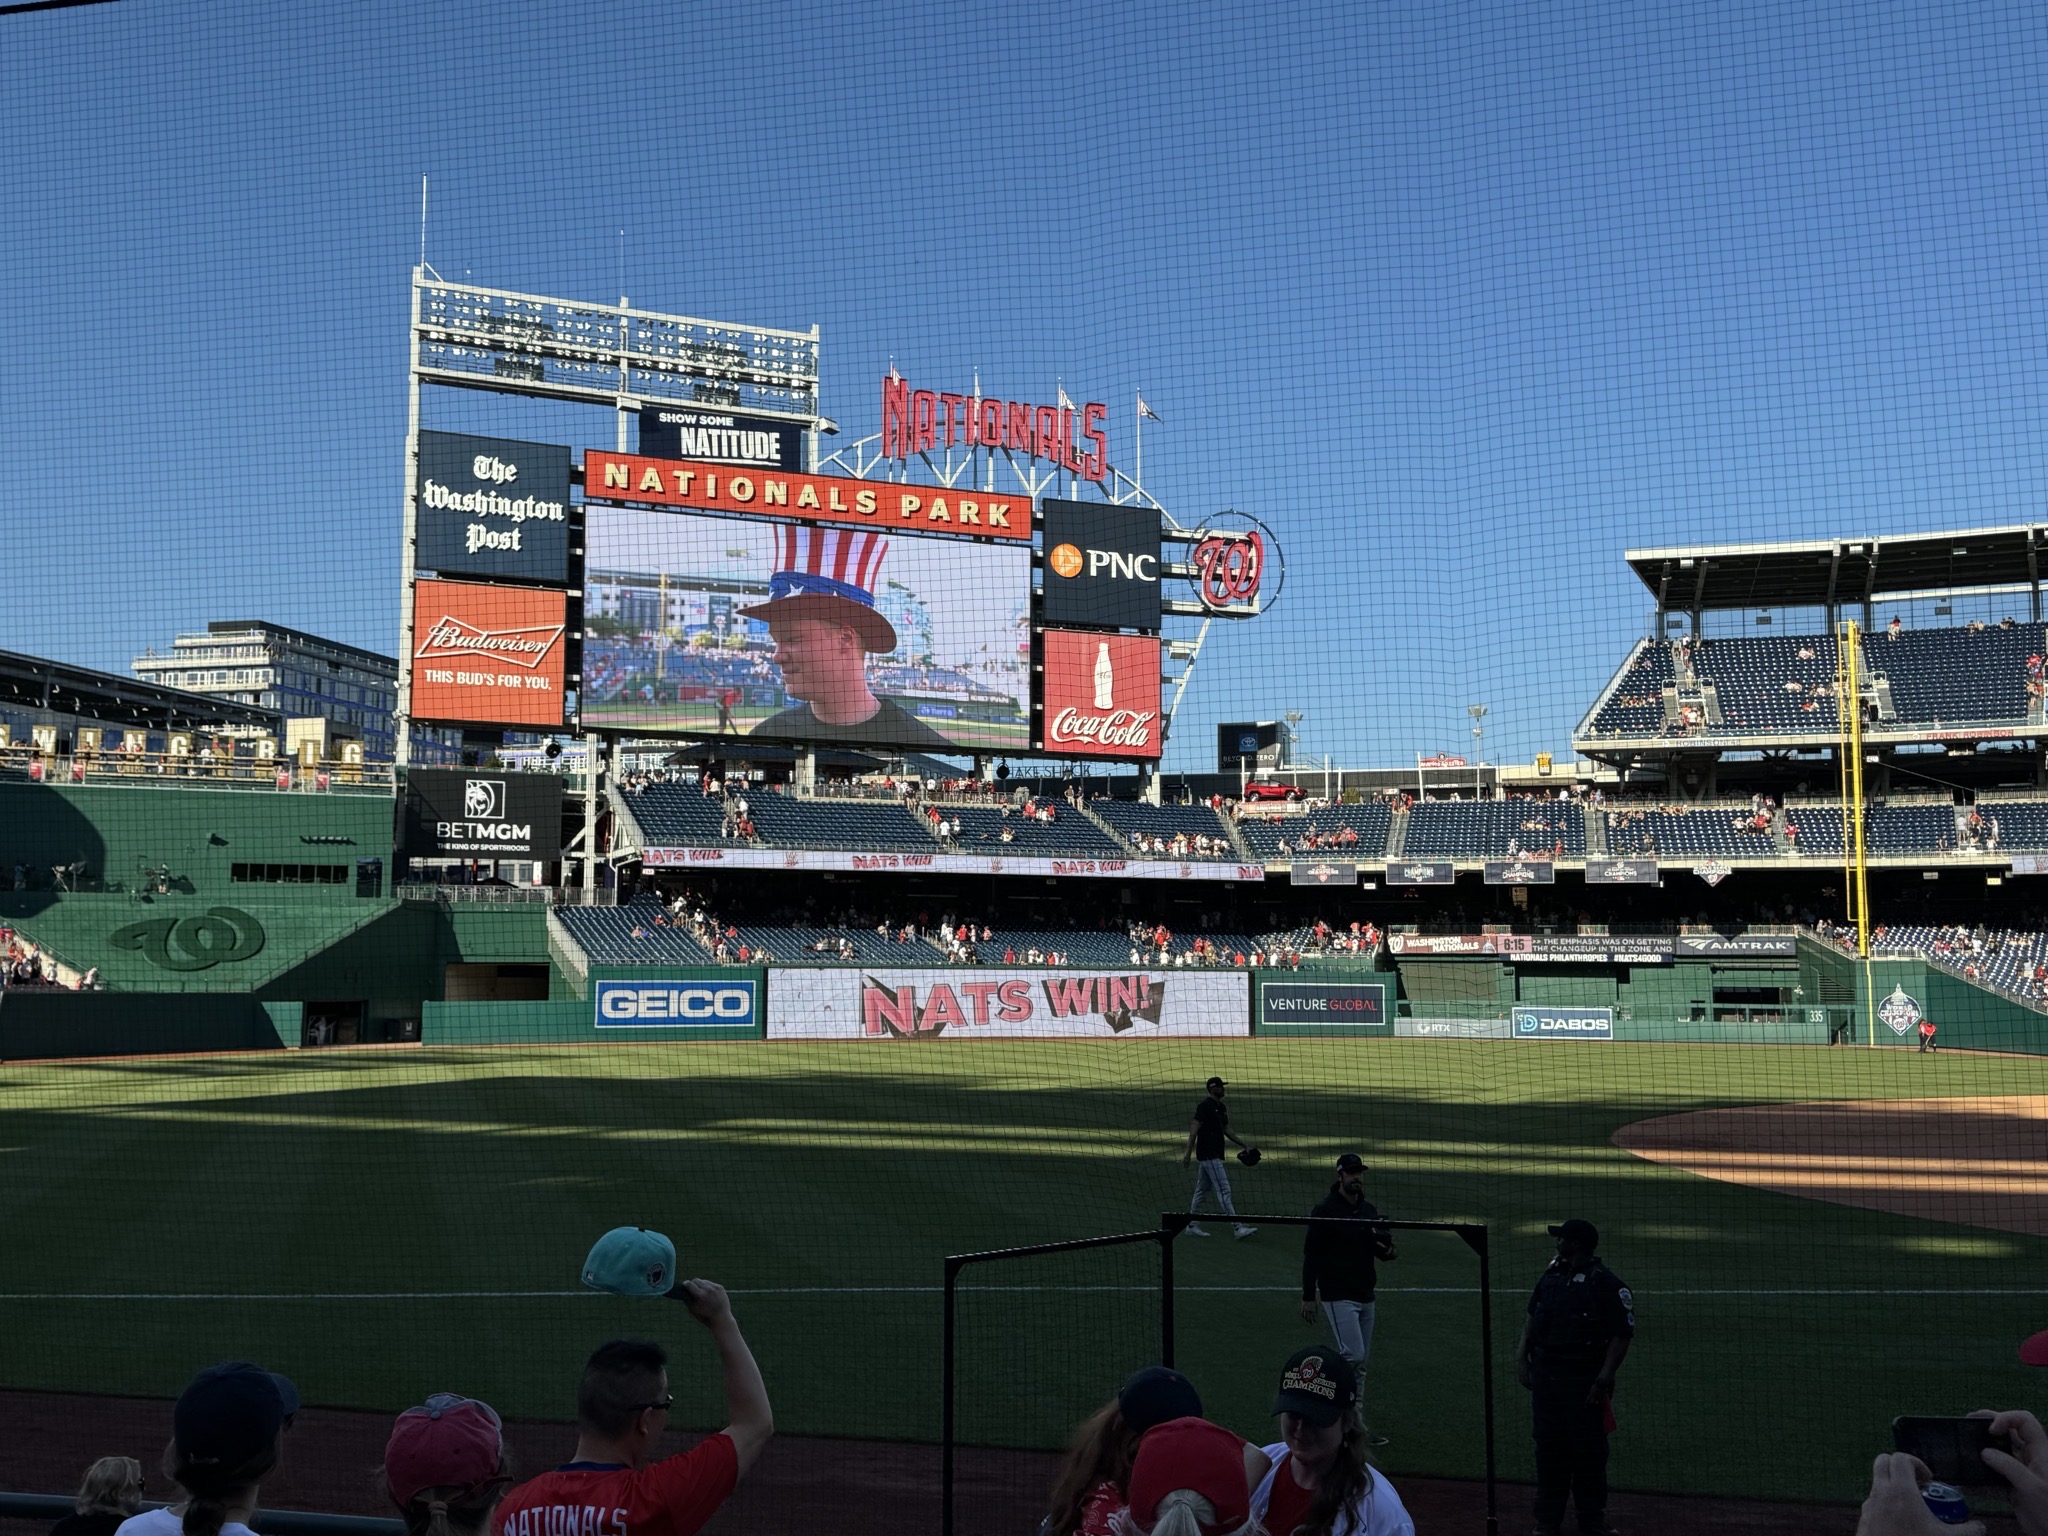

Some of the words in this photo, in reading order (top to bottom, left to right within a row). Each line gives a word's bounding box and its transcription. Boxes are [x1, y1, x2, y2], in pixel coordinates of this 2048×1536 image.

[659, 412, 697, 424] SHOW
[699, 415, 734, 426] SOME
[881, 376, 1106, 482] NATIONALS
[680, 426, 781, 460] NATITUDE
[473, 455, 517, 484] The
[423, 479, 565, 522] Washington
[604, 462, 878, 514] NATIONALS
[901, 494, 1011, 528] PARK
[466, 523, 522, 554] Post
[1086, 549, 1157, 582] PNC
[429, 625, 549, 653] Budweiser
[425, 669, 453, 683] THIS
[457, 672, 494, 686] BUD'S
[498, 674, 521, 688] FOR
[525, 676, 552, 691] YOU.
[1050, 706, 1156, 747] Coca-Cola
[1926, 732, 1958, 740] FRANK
[1963, 729, 2014, 739] ROBINSON
[1043, 764, 1091, 778] SHACK
[437, 821, 531, 840] BETMGM
[852, 855, 899, 869] NATS
[902, 854, 933, 866] WIN!
[1052, 860, 1095, 875] NATS
[1099, 860, 1127, 872] WIN!
[1406, 936, 1461, 947] WASHINGTON
[1432, 941, 1479, 952] NATIONALS
[1503, 938, 1525, 951] 6:15
[1710, 941, 1788, 950] AMTRAK
[1510, 953, 1548, 962] NATIONALS
[1550, 953, 1609, 962] PHILANTHROPIES
[1613, 953, 1661, 962] #NATS4GOOD
[601, 989, 750, 1019] GEICO
[863, 980, 1034, 1036] NATS
[1043, 975, 1149, 1018] WIN!
[1269, 998, 1327, 1011] VENTURE
[1329, 999, 1378, 1011] GLOBAL
[1540, 1018, 1609, 1031] DABOS
[1809, 1010, 1823, 1023] 335
[1431, 1023, 1451, 1032] RTX
[1282, 1379, 1336, 1400] CHAMPIONS
[503, 1505, 628, 1536] NATIONALS
